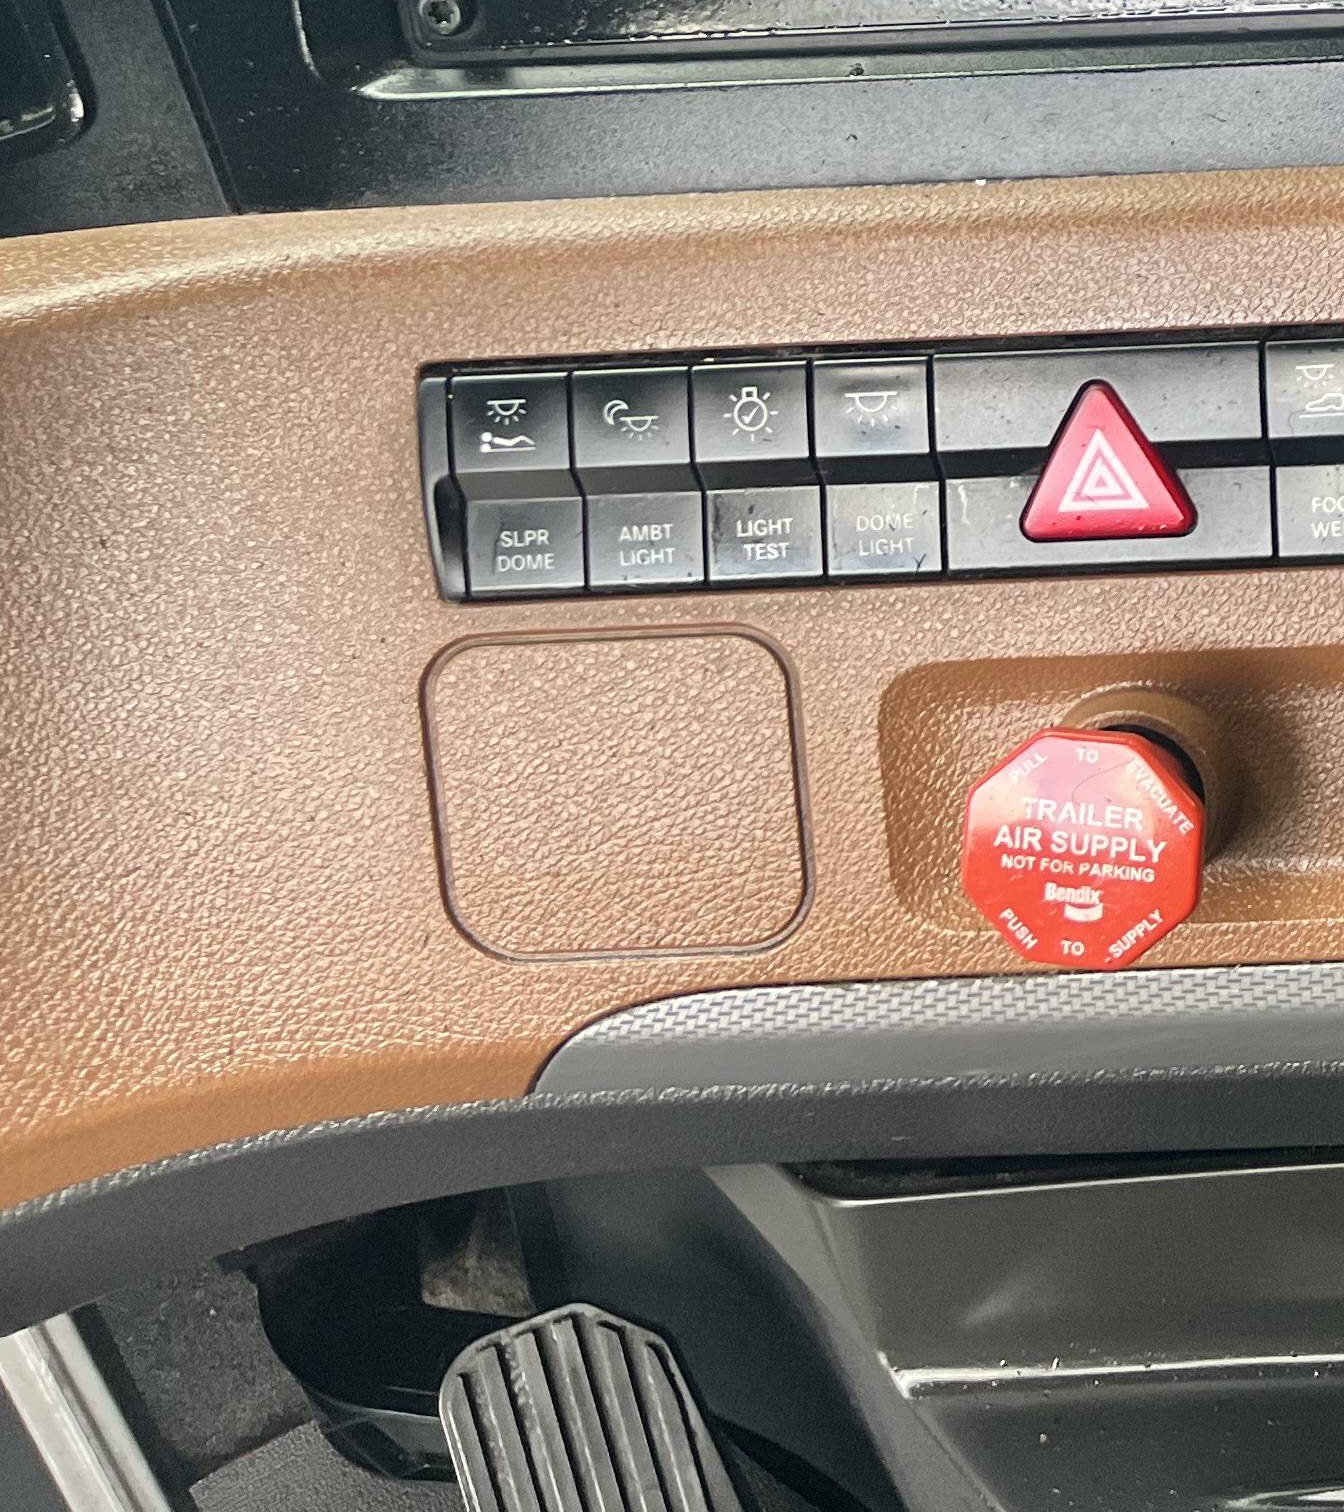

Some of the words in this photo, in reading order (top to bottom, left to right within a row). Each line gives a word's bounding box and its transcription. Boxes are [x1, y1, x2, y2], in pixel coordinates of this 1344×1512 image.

[736, 517, 793, 538] LIGHT
[856, 512, 915, 532] DOME
[499, 528, 549, 548] SLPR
[619, 523, 673, 543] AMBT
[743, 541, 790, 561] TEST
[858, 536, 915, 557] LIGHT
[496, 552, 555, 572] DOME
[620, 548, 675, 568] LIGHT
[1008, 750, 1048, 784] PULL
[1075, 747, 1099, 763] TO
[1126, 758, 1195, 836] EVACUATE
[1020, 796, 1144, 831] TRAILER
[993, 824, 1043, 852] AIR
[1050, 830, 1168, 864] SUPPLY
[1001, 853, 1037, 870] NOT
[1040, 858, 1074, 874] FOR
[1078, 862, 1156, 883] PARKING
[1044, 882, 1104, 905] Bendix
[999, 907, 1039, 950] PUSH
[1061, 939, 1085, 956] TO
[1107, 909, 1164, 959] SUPPLY
